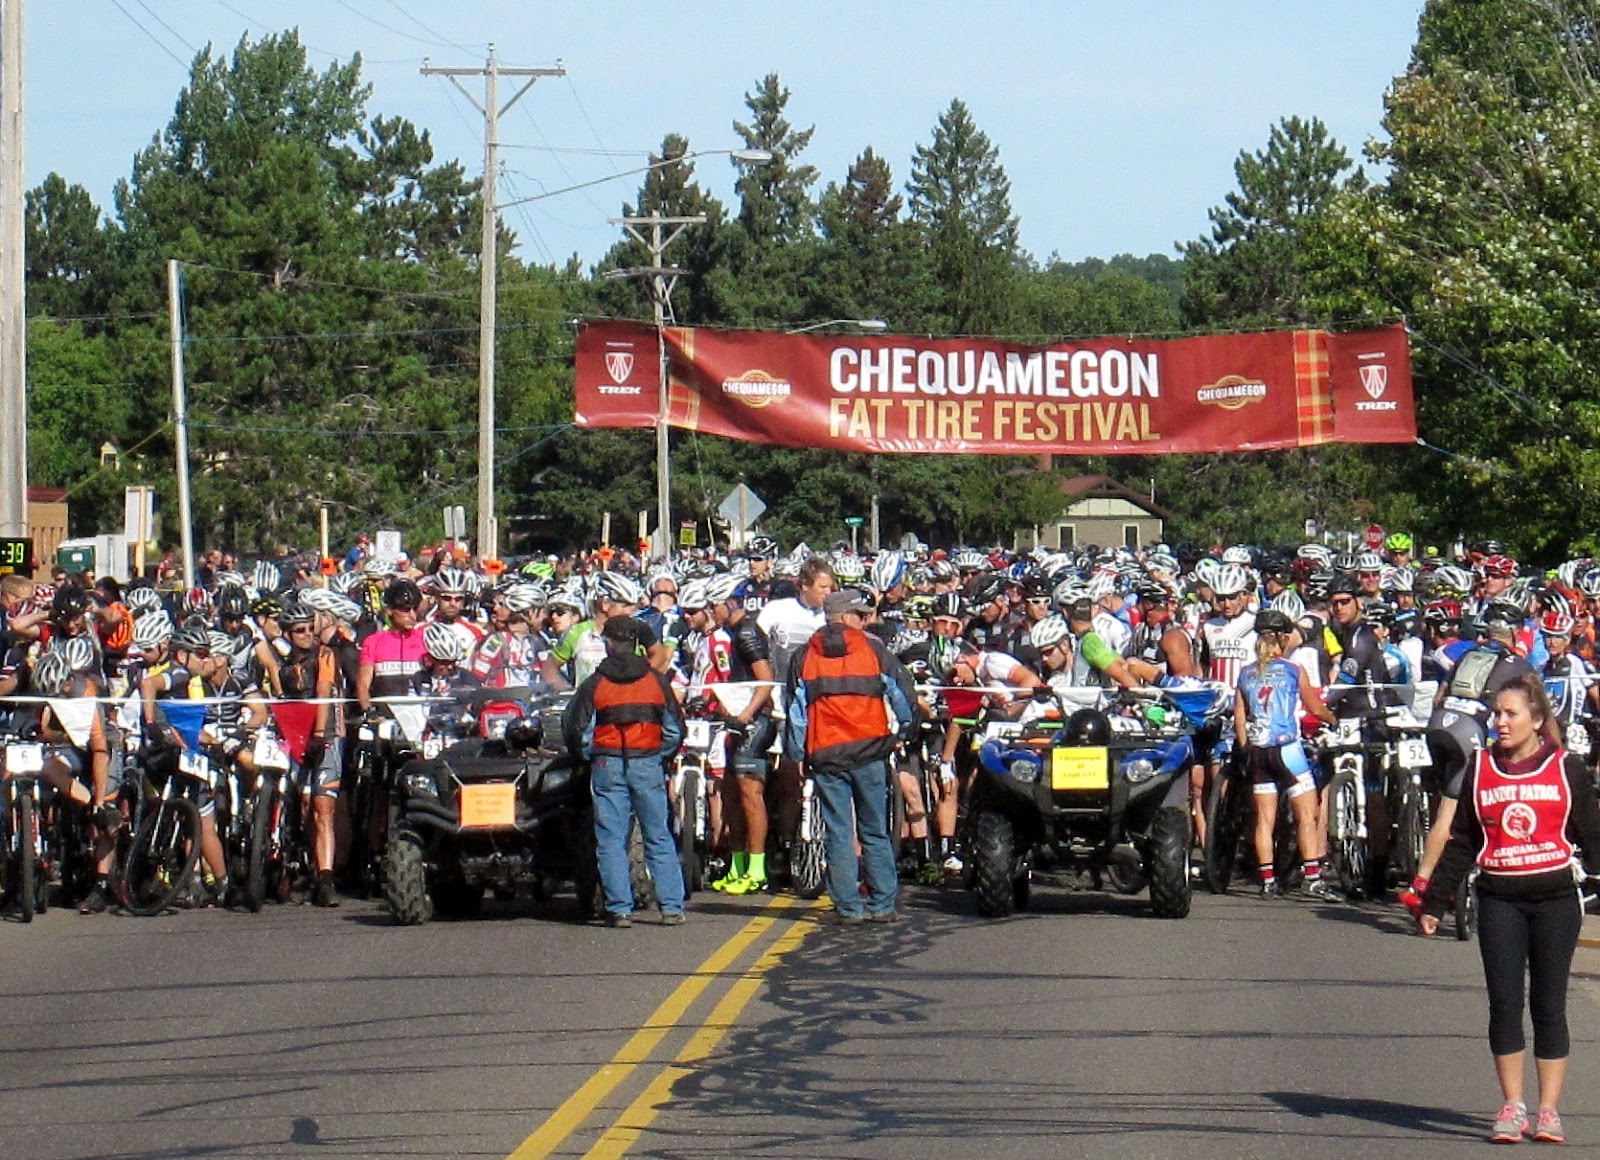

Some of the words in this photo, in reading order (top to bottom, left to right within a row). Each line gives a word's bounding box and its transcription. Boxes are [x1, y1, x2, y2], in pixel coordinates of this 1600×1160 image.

[830, 347, 1160, 398] CHEQUAMEGON
[597, 385, 641, 395] TREK
[722, 381, 791, 396] CHEQUAMEGON
[1197, 384, 1266, 402] CHEQUAMEGON
[1355, 401, 1397, 410] TREK
[830, 398, 894, 438] FAT
[902, 399, 983, 440] TIRE
[993, 401, 1162, 441] FESTIVAL
[264, 744, 281, 761] 32
[1408, 744, 1426, 760] 52
[1480, 784, 1518, 807] BANDIT
[1519, 784, 1562, 801] PATROL
[1524, 849, 1567, 865] FESTIVAL
